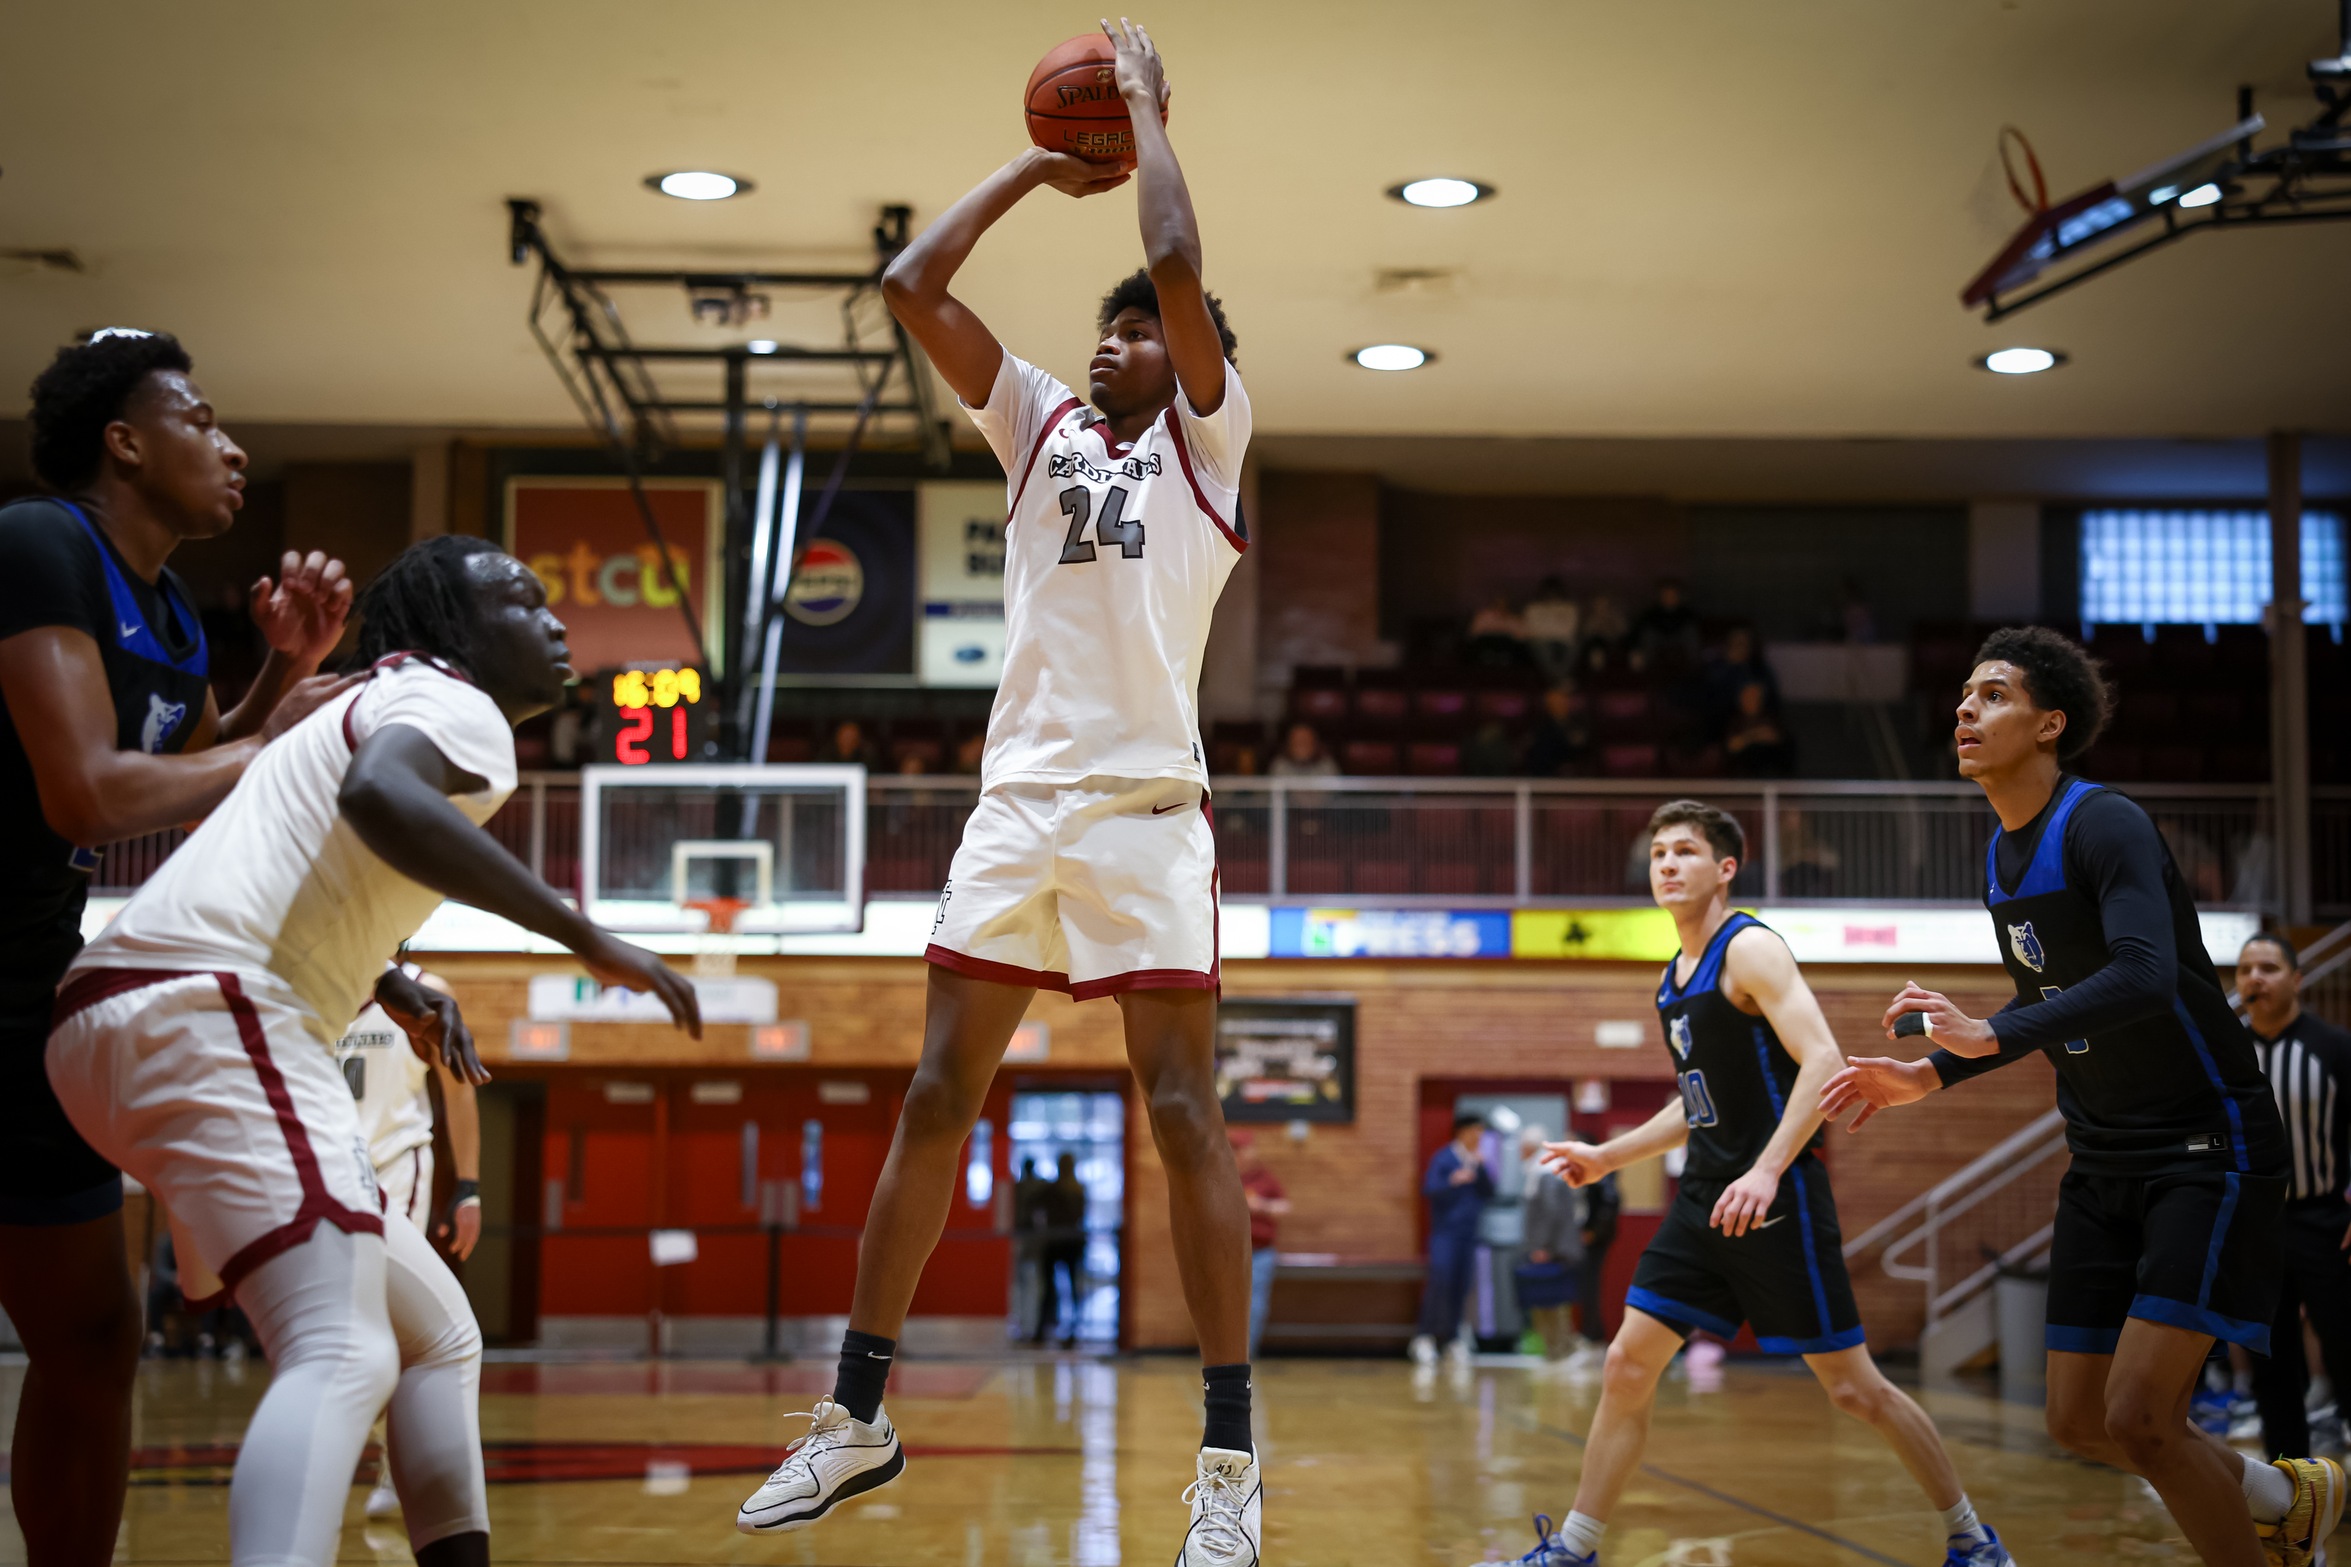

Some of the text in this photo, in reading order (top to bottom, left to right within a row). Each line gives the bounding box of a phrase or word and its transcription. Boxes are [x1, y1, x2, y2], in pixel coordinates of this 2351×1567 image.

[1056, 85, 1120, 109] SPALD
[1063, 128, 1135, 146] LEGAC
[1049, 453, 1162, 482] CARDIALS
[1058, 485, 1145, 564] 24
[530, 542, 690, 608] stcu
[616, 705, 687, 765] 21
